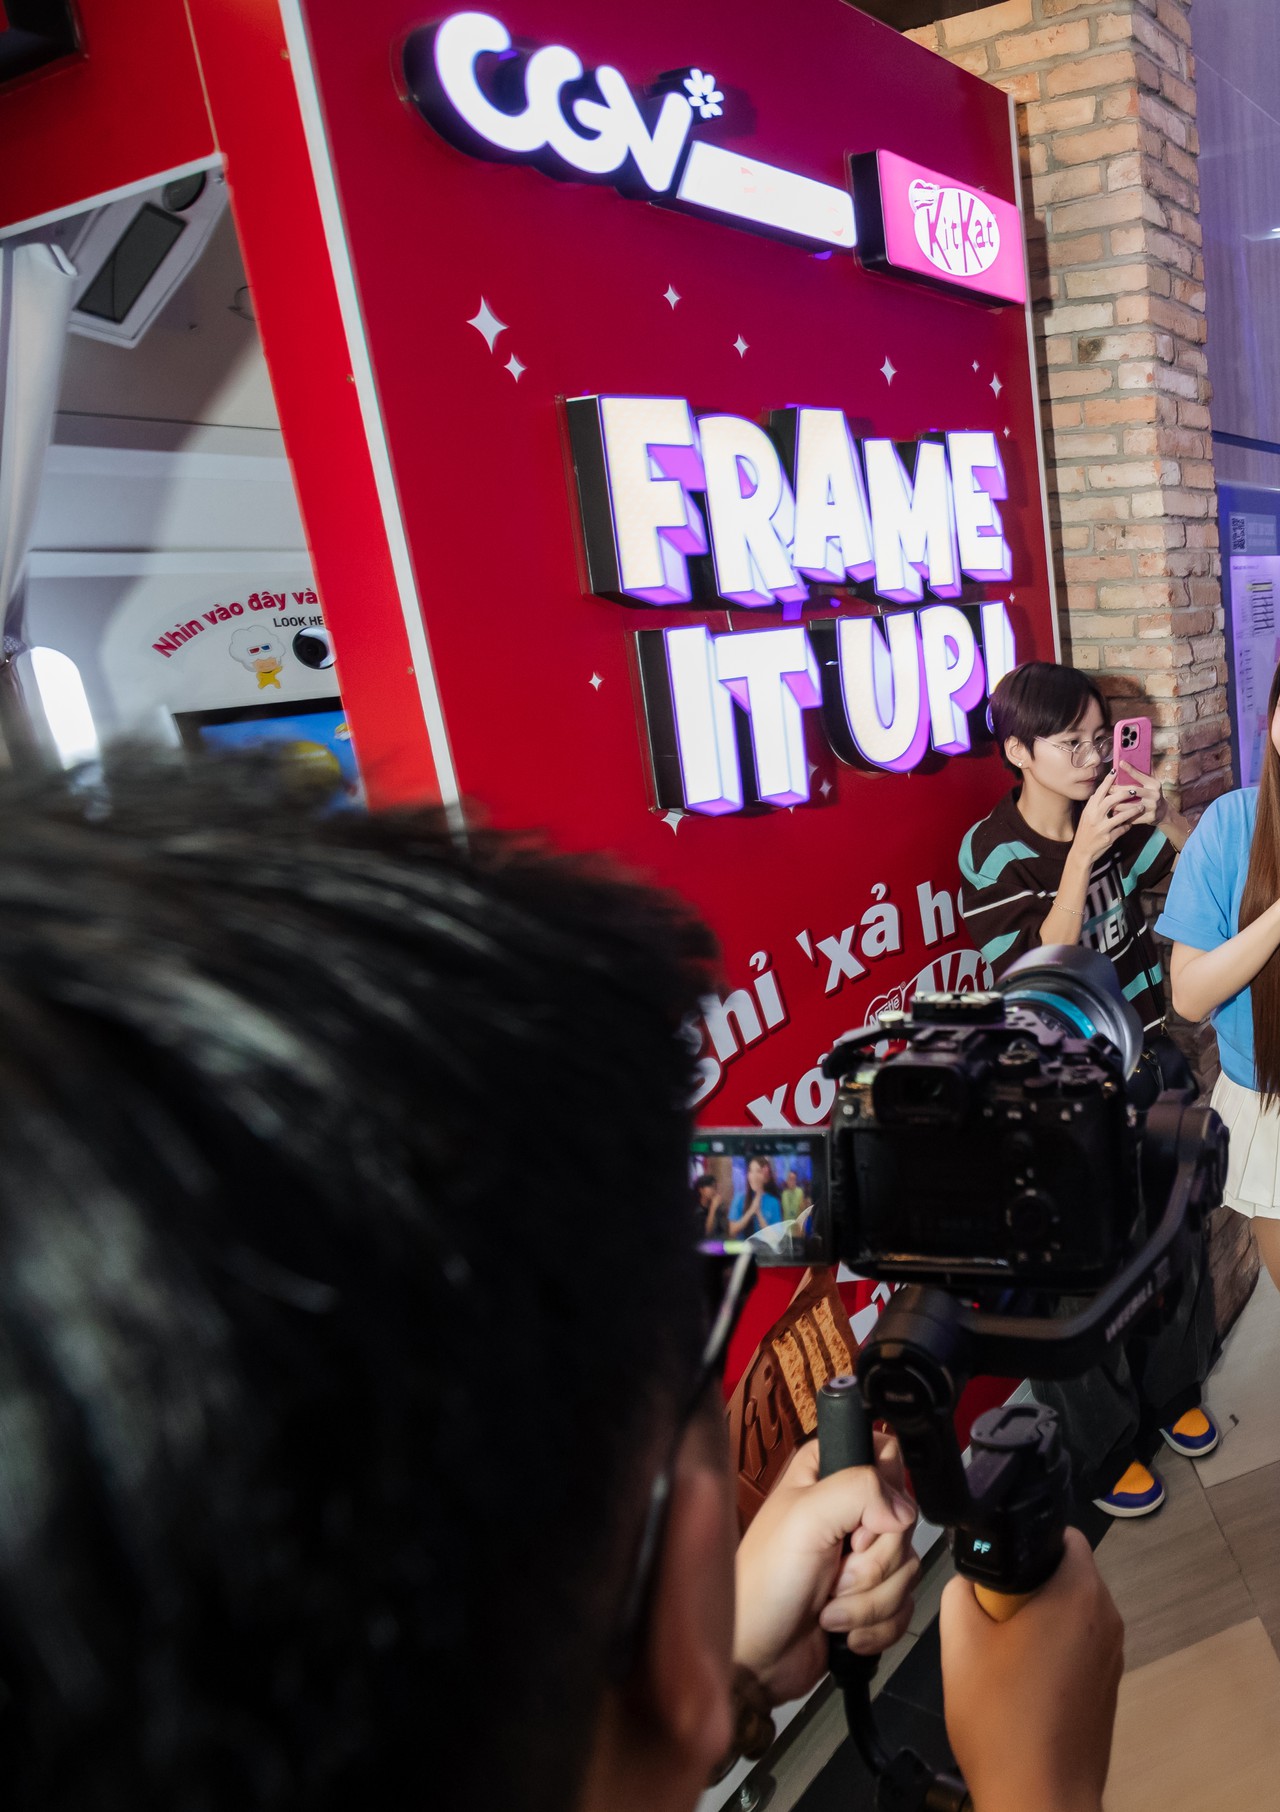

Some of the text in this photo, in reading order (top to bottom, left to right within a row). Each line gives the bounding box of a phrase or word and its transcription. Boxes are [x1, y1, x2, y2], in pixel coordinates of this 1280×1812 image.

[434, 10, 694, 193] CGV
[926, 191, 994, 273] KitKat
[598, 394, 1012, 608] FRAME
[152, 587, 319, 659] Nhìn vào đây và
[273, 615, 325, 628] LOOK HE
[664, 600, 1017, 817] IT UP!
[916, 880, 965, 947] h
